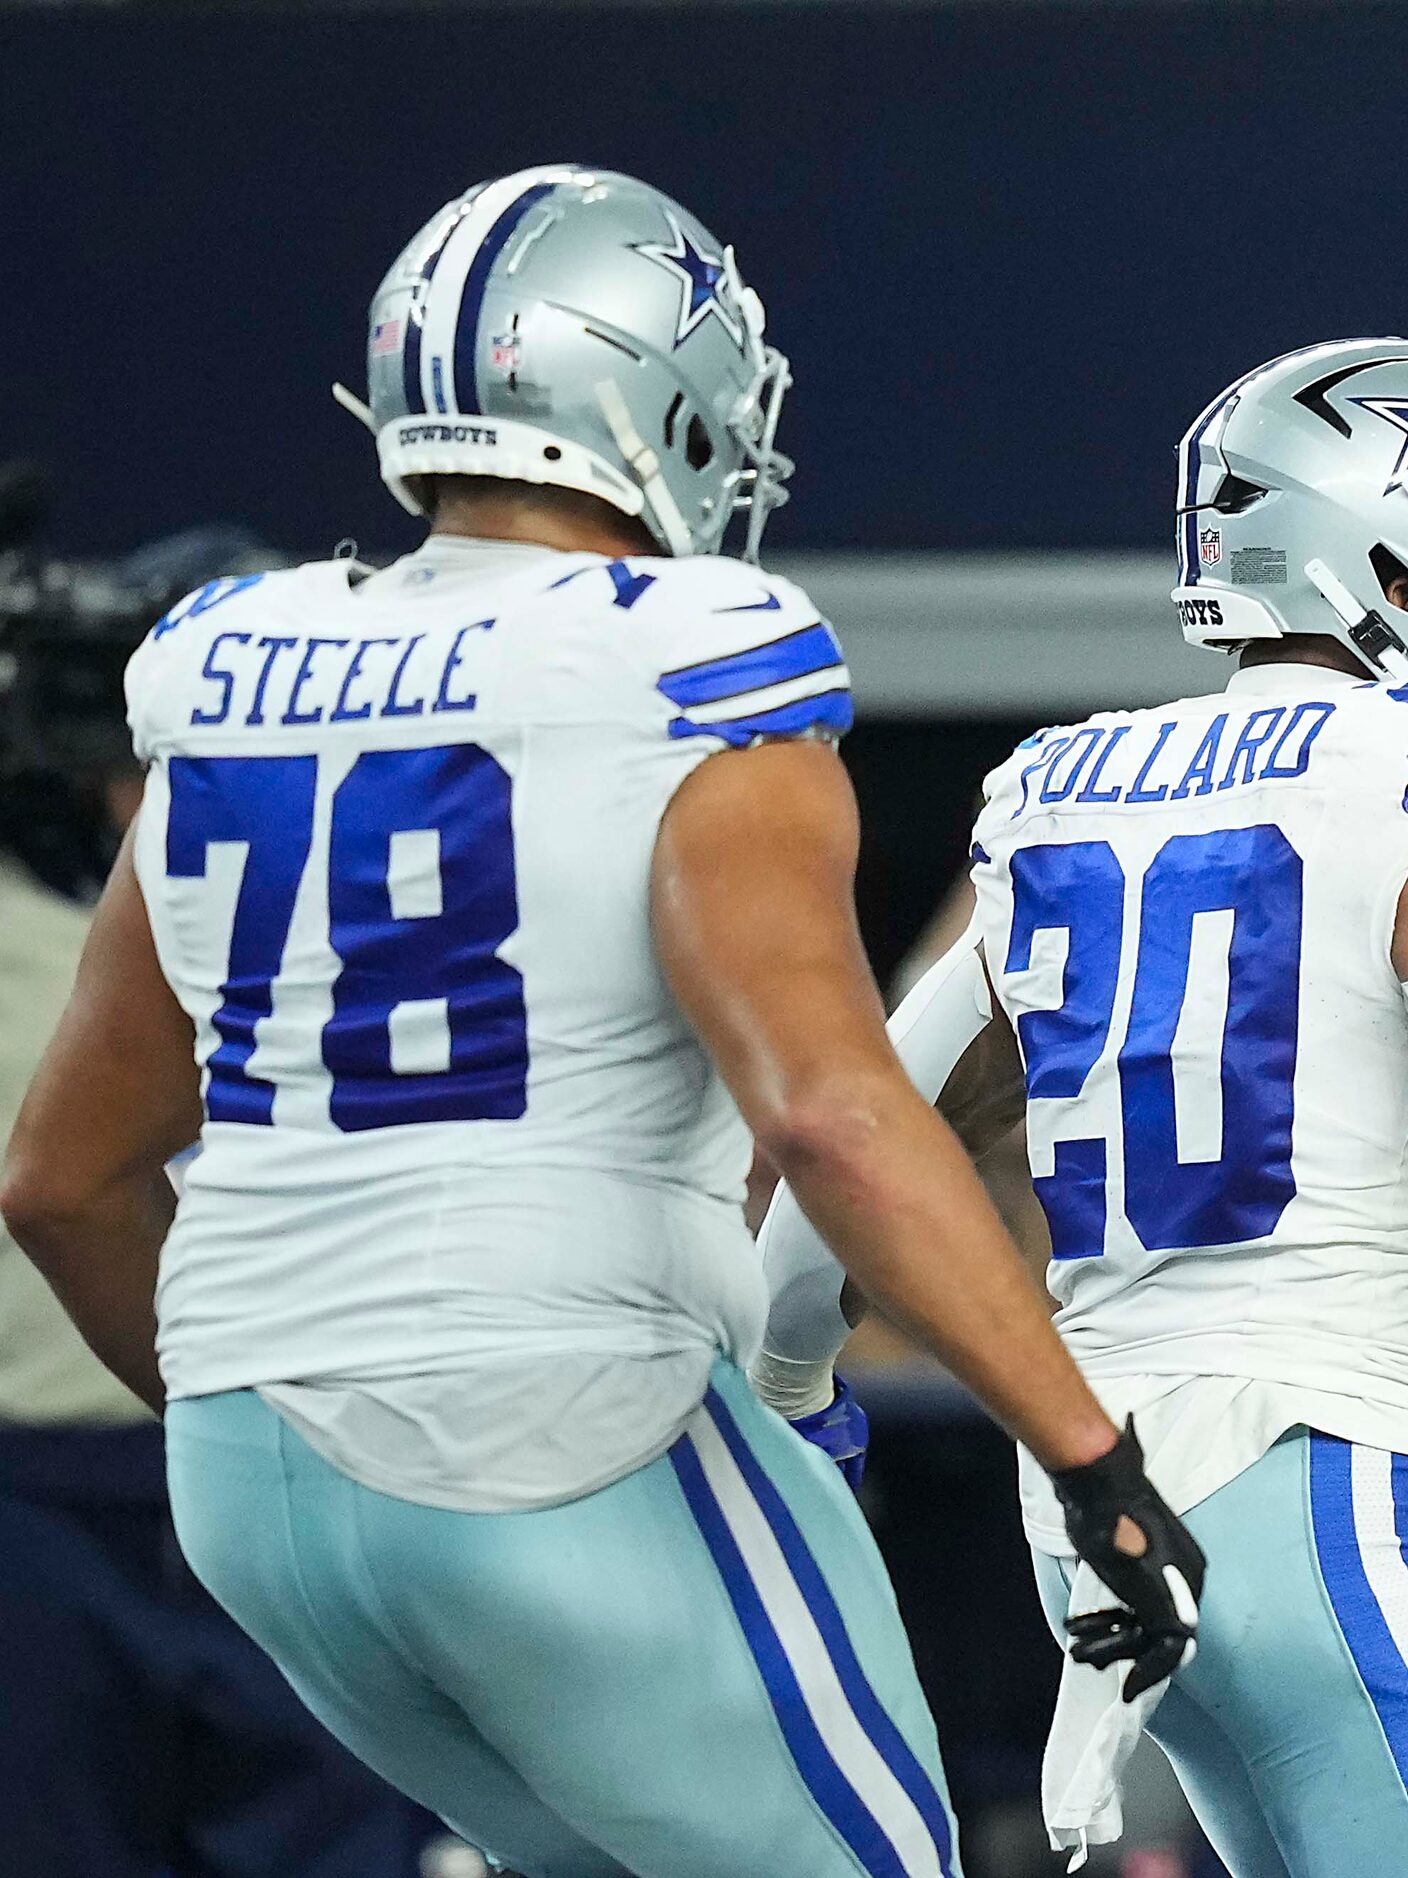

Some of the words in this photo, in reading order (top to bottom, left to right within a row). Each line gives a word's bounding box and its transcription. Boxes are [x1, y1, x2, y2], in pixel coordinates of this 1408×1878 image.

[1202, 544, 1219, 562] NFL
[190, 619, 496, 726] STEELE
[1010, 701, 1337, 820] POLLARD
[165, 742, 529, 1133] 78
[1004, 824, 1304, 1261] 20
